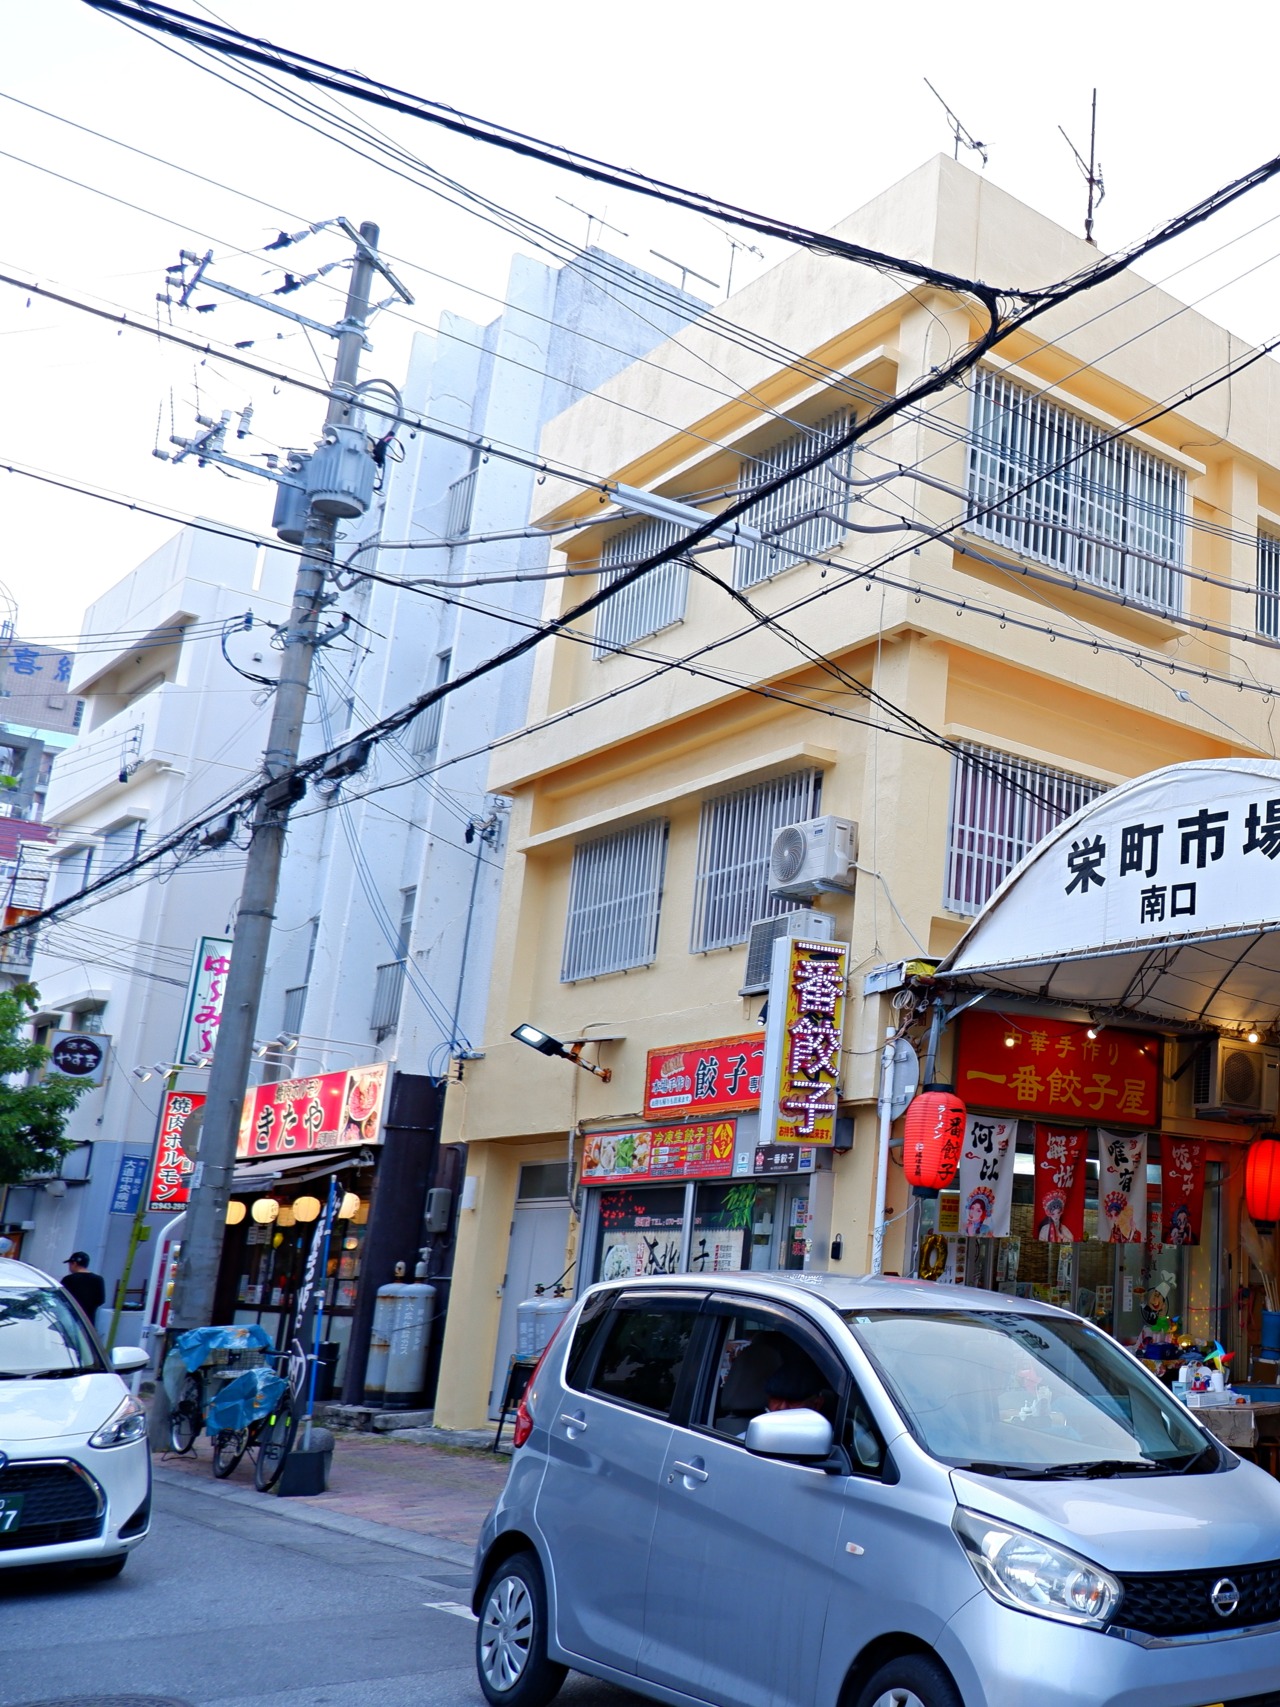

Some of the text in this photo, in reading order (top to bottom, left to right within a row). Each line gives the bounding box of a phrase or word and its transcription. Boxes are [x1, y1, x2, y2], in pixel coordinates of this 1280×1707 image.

[1140, 882, 1197, 924] 南口
[56, 1052, 98, 1068] やす吉
[785, 941, 847, 1134] 一番餃子
[1003, 1027, 1119, 1066] 中華手作り
[694, 1054, 748, 1099] 餃子
[966, 1064, 1150, 1117] 一番餃子屋
[255, 1099, 325, 1153] きたや
[933, 1104, 946, 1139] ラーメン
[937, 1108, 965, 1181] 一番餃子
[156, 1095, 193, 1202] 焼肉ホルモン
[767, 1152, 795, 1164] 一番餃子
[1108, 1139, 1135, 1192] 唯有
